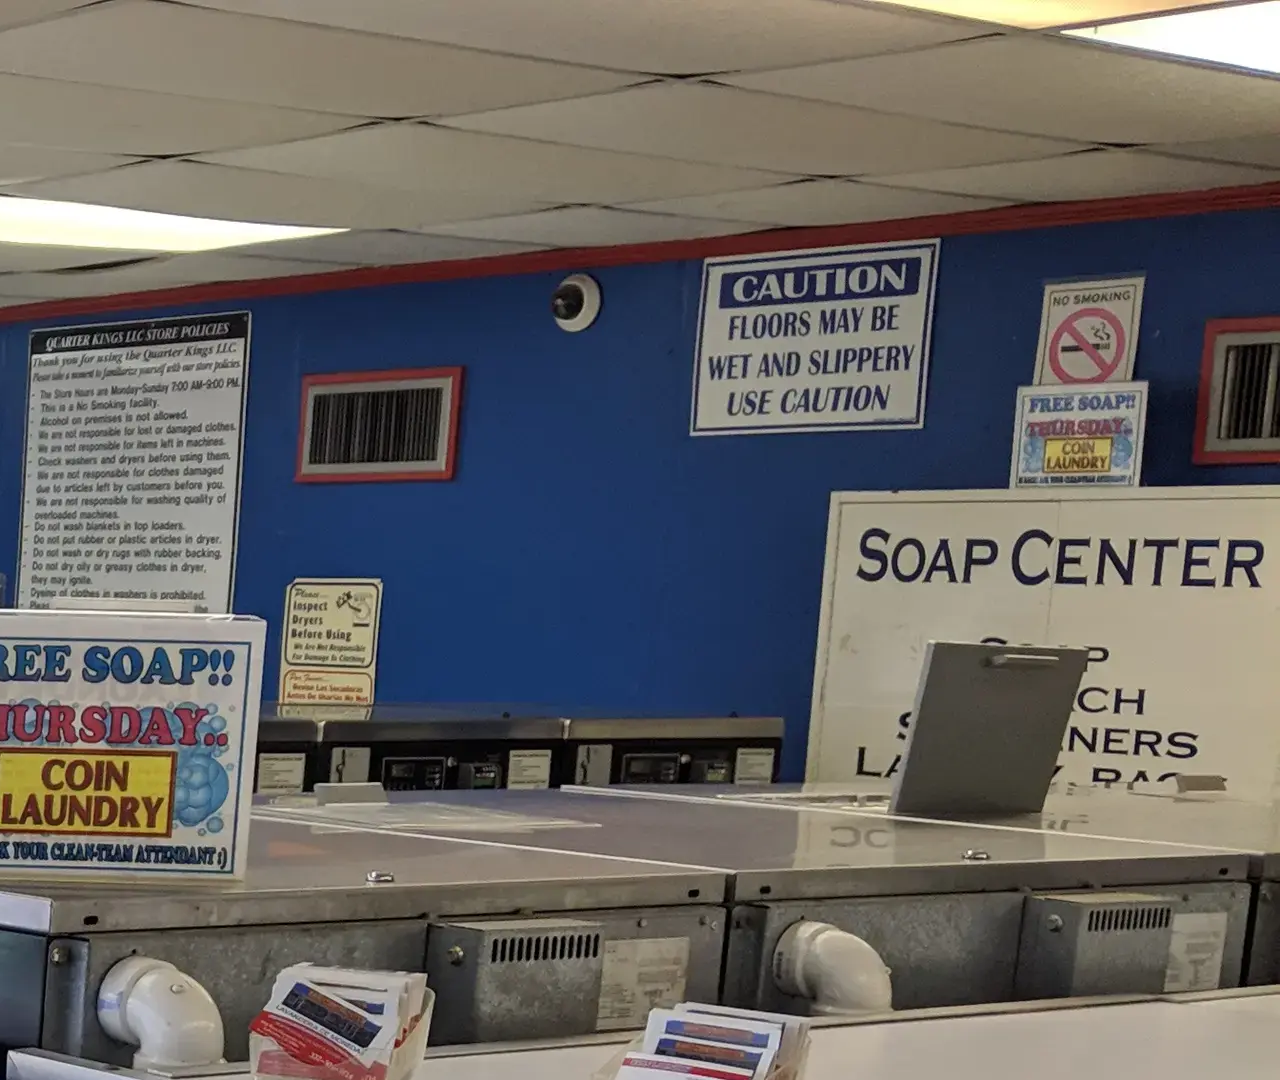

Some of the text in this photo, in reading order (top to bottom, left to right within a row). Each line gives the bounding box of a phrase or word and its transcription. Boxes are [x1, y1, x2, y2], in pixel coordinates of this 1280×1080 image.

[733, 264, 906, 301] CAUTION
[1053, 291, 1130, 306] NO SMOKING
[728, 304, 900, 340] FLOORS MAY BE
[46, 322, 230, 352] QUARTER KINGS LLC STORE POLICIES
[33, 355, 59, 368] Thank
[60, 357, 78, 369] you
[78, 353, 95, 367] for
[97, 352, 123, 364] using
[125, 350, 141, 360] the
[143, 347, 183, 362] Quarter
[184, 345, 214, 358] Kings
[709, 344, 914, 380] WET AND SLIPPERY
[40, 390, 52, 399] The
[54, 389, 72, 399] Store
[75, 389, 94, 397] Hours
[96, 388, 108, 396] are
[110, 383, 169, 396] Monday-Sunday
[172, 381, 188, 392] 7:00
[41, 403, 55, 412] This
[76, 402, 88, 410] No
[91, 400, 126, 410] Smoking
[129, 397, 160, 408] facility.
[727, 384, 890, 416] USE CAUTION
[1029, 394, 1135, 412] FREE SOAP!!
[40, 416, 69, 426] Alcohol
[72, 417, 82, 425] on
[84, 414, 122, 426] premises
[136, 412, 150, 421] not
[154, 409, 188, 420] allowed.
[1062, 442, 1095, 455] COIN
[38, 456, 61, 466] Check
[65, 456, 97, 465] washers
[101, 454, 116, 464] and
[119, 454, 145, 465] dryers
[148, 452, 176, 463] before
[180, 452, 203, 463] using
[1046, 456, 1107, 469] LAUNDRY
[34, 522, 45, 531] Do
[48, 523, 60, 531] not
[86, 521, 120, 530] blankets
[124, 521, 131, 530] in
[135, 522, 148, 531] top
[151, 520, 185, 530] loaders.
[855, 528, 1265, 588] SOAP CENTER
[293, 601, 328, 613] Inspect
[292, 615, 323, 627] Dryers
[291, 629, 352, 642] Before Using
[329, 644, 366, 653] Responsible
[82, 645, 235, 687] SOAP!!
[304, 654, 329, 662] Damage
[339, 655, 365, 664] Clothing
[41, 758, 129, 792] COIN
[1, 793, 164, 828] LAUNDRY
[12, 841, 49, 861] YOUR
[50, 842, 133, 862] CLEAN-TEAM
[135, 844, 214, 865] ATTENDANT
